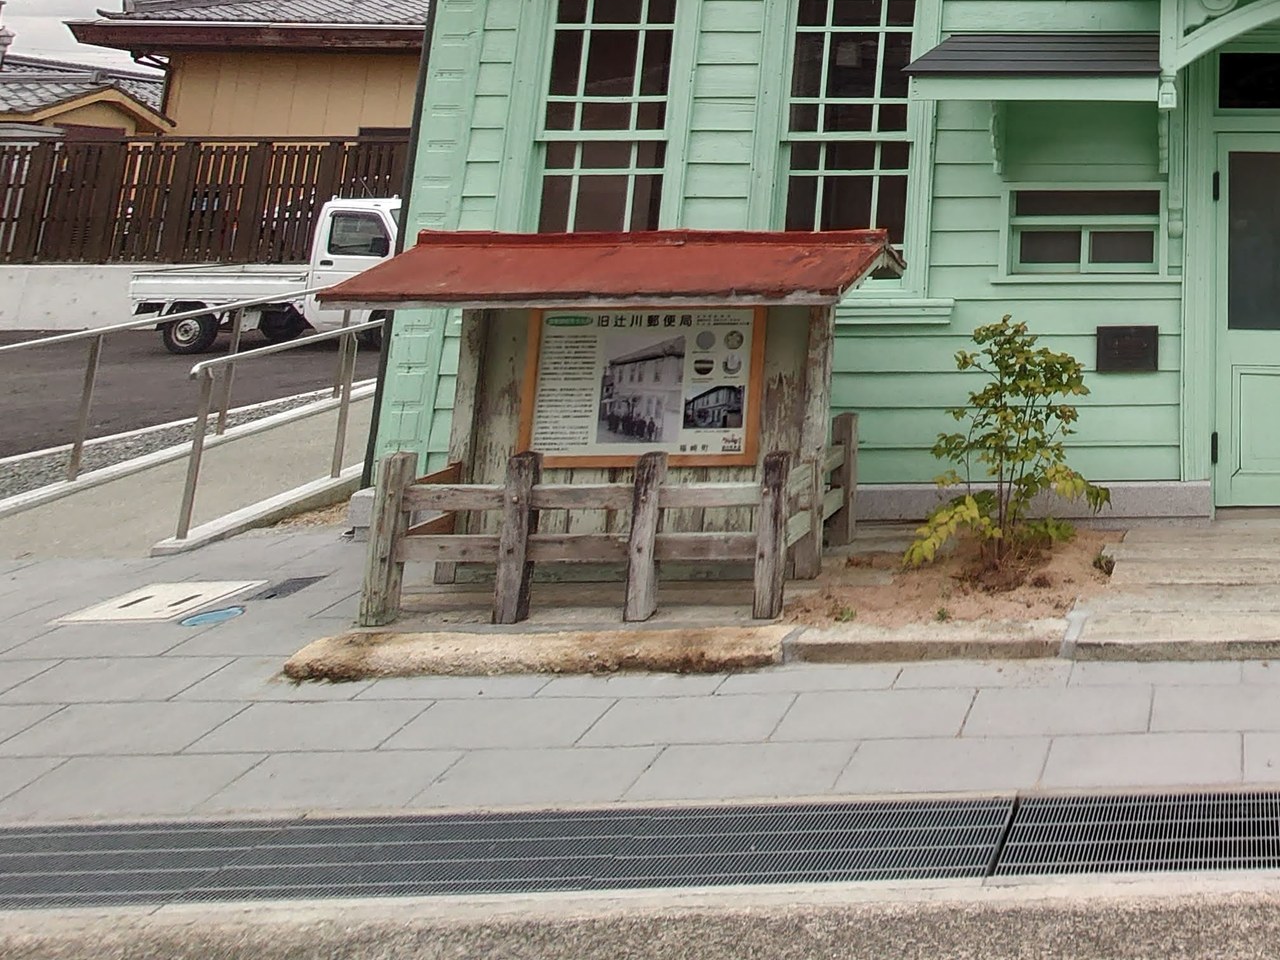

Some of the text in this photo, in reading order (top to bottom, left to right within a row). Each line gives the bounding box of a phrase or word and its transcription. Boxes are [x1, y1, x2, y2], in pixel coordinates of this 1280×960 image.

[597, 314, 693, 328] 旧辻川郵便局
